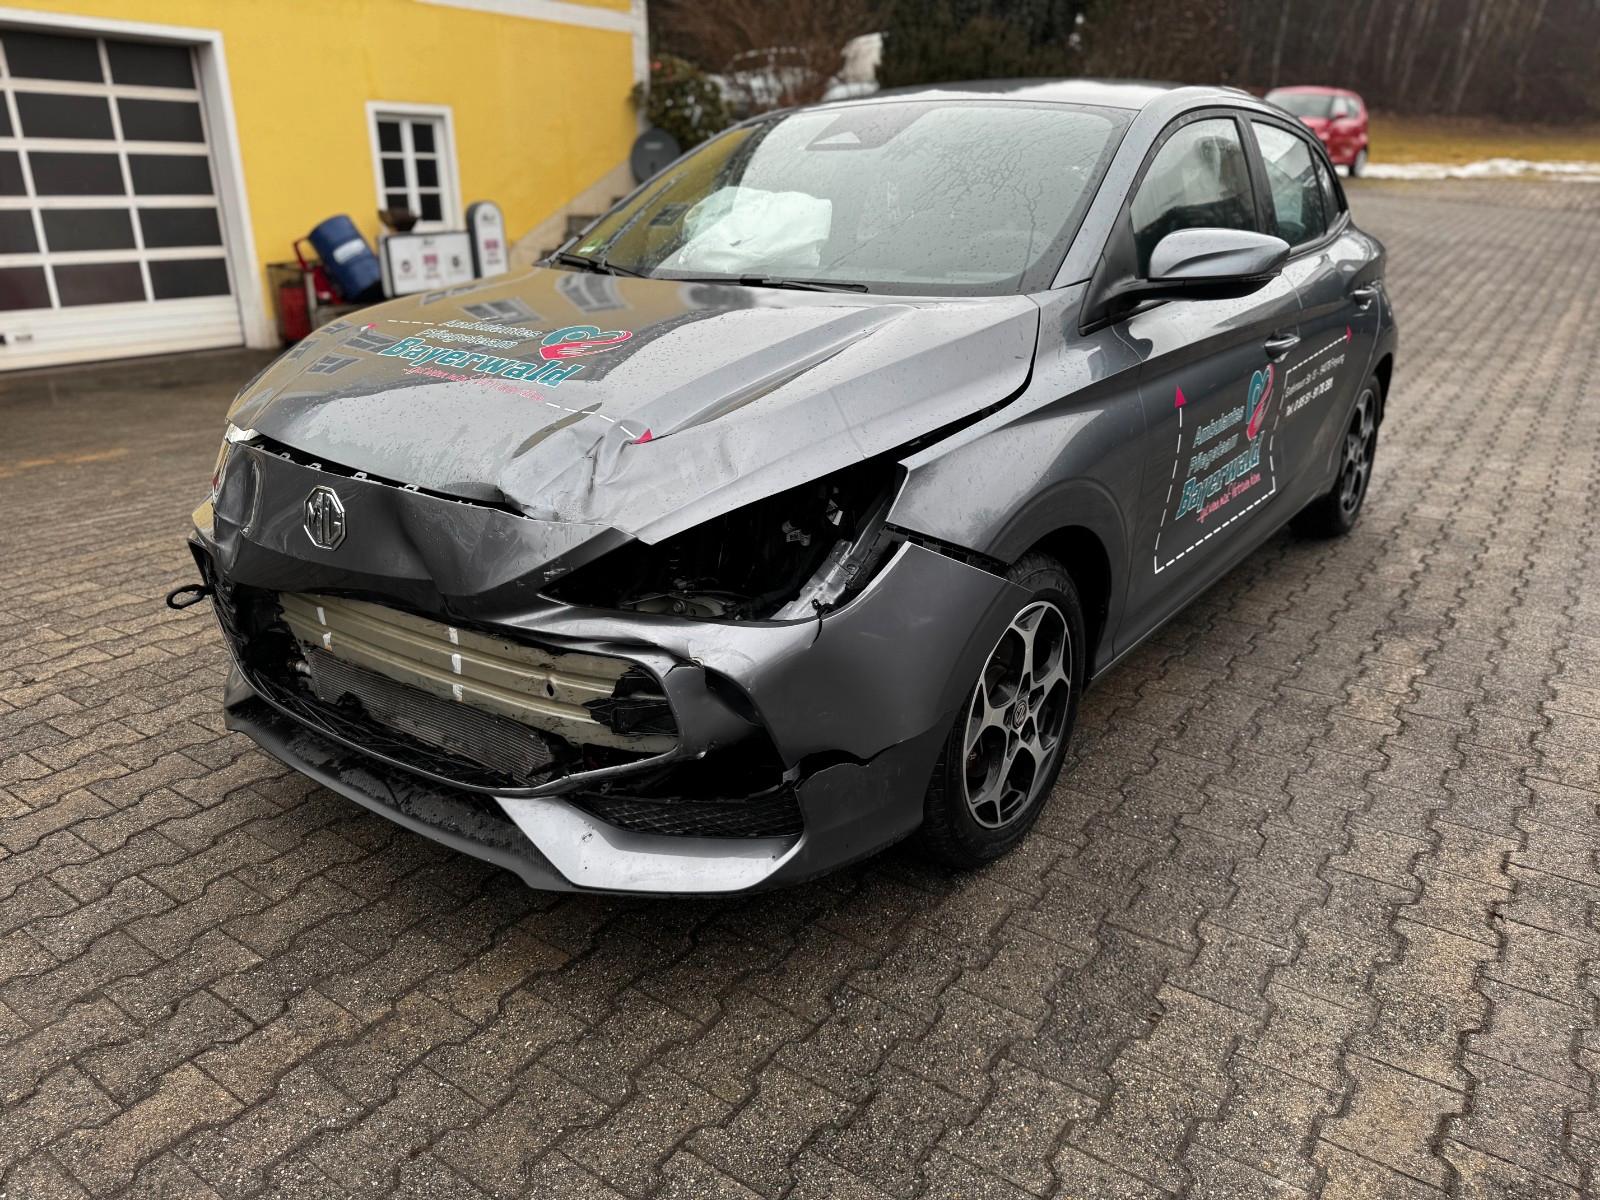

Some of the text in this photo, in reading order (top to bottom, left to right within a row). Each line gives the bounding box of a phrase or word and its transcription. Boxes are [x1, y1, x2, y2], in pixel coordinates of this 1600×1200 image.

[437, 319, 542, 337] Ambulantes
[377, 336, 586, 389] Bayerwald
[1192, 405, 1245, 449] Ambulantes
[1175, 430, 1265, 520] Bayerwald
[1187, 433, 1239, 478] Pflegeteam
[305, 489, 345, 549] MG
